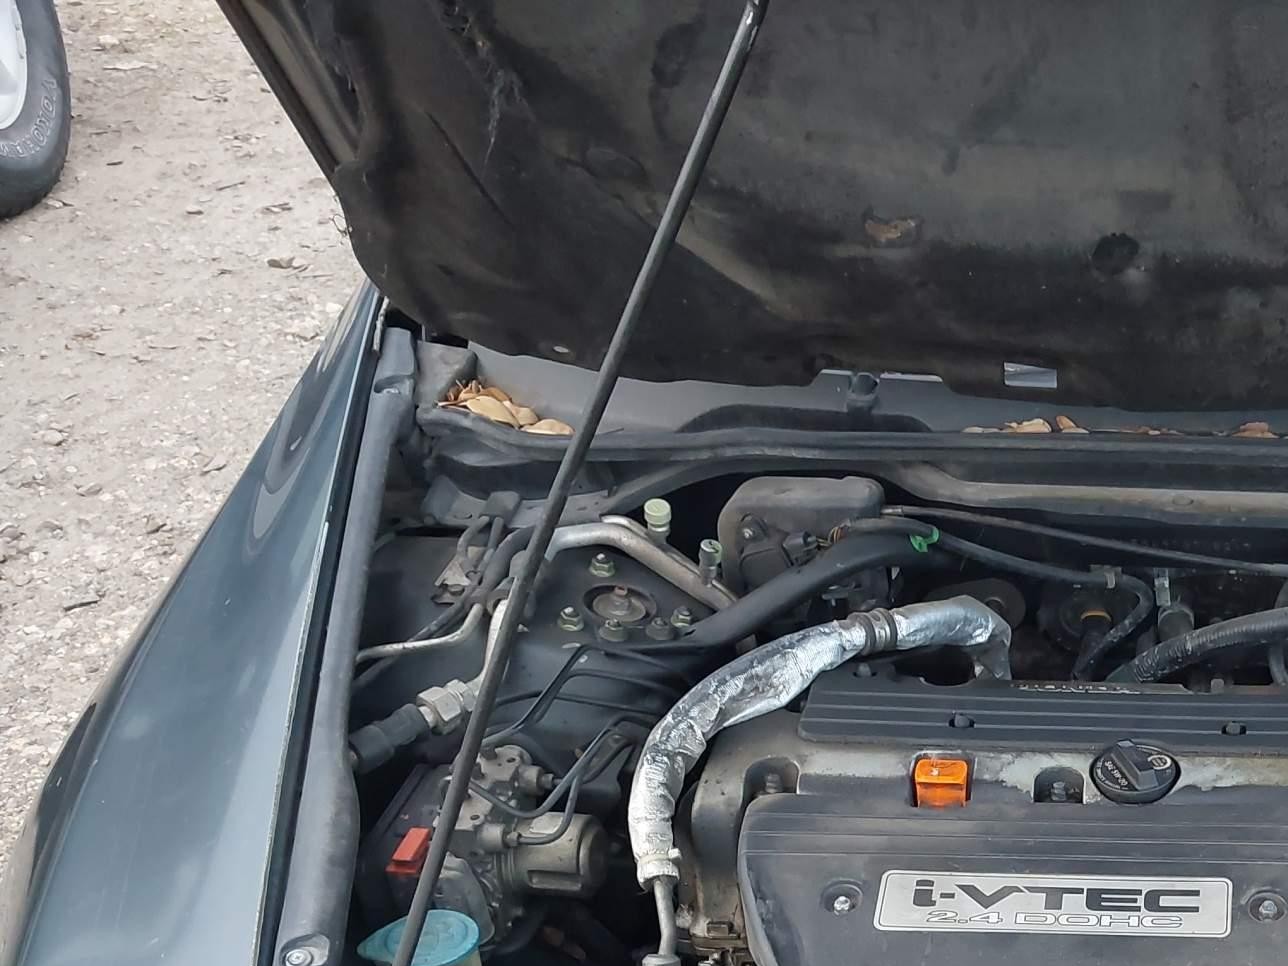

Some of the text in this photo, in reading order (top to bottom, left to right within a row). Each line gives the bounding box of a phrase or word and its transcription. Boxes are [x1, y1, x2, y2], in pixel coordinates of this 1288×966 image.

[912, 879, 1201, 913] i-VTEC
[925, 910, 1184, 928] 2.4 DOHC
